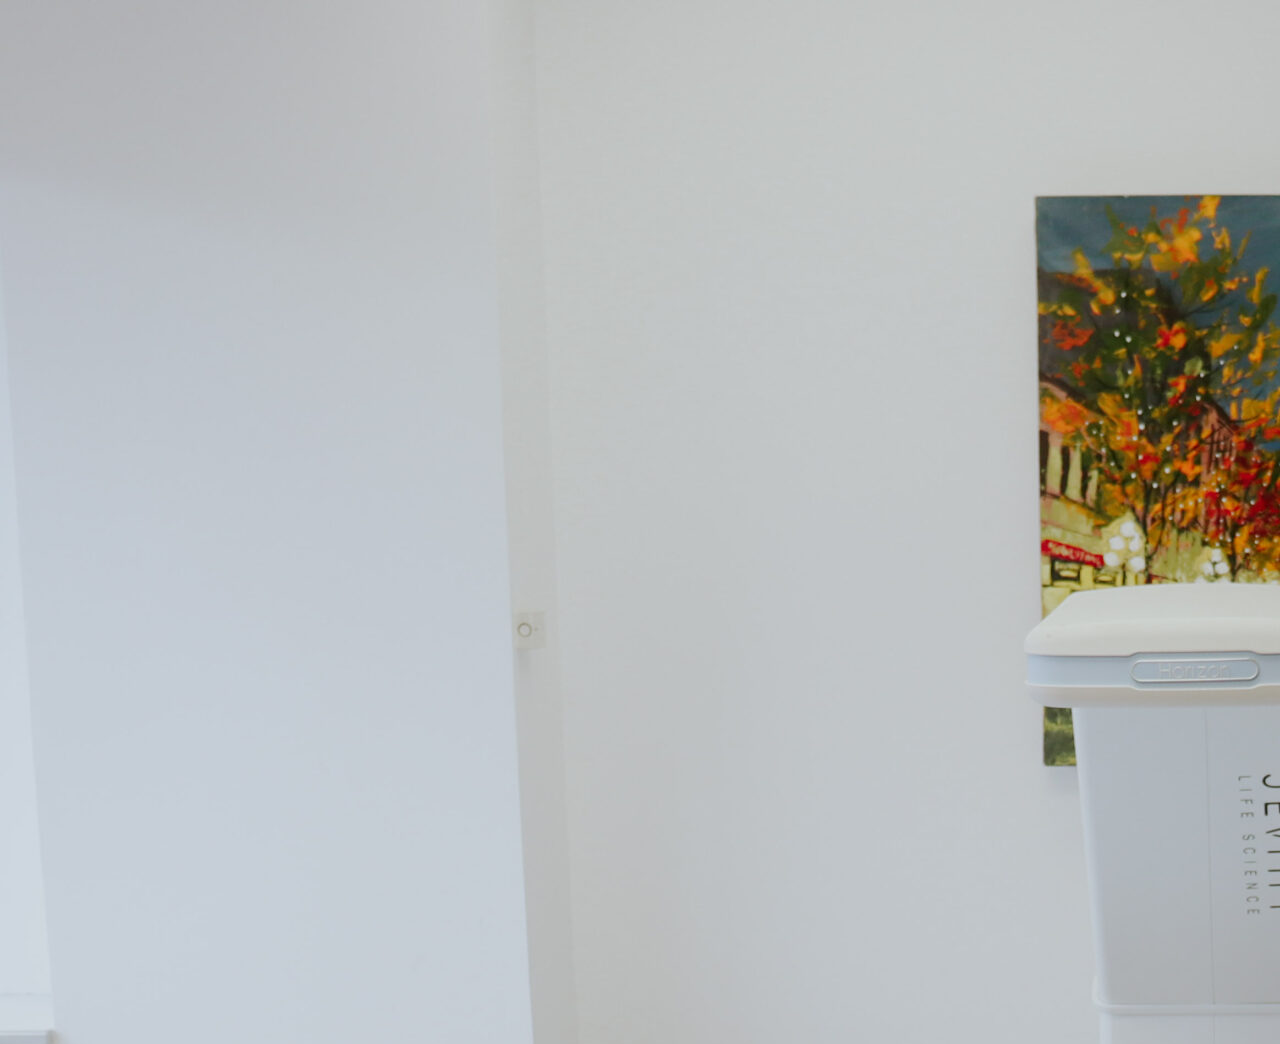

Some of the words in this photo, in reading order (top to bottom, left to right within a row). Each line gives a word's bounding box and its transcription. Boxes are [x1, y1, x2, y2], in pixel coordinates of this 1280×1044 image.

[1158, 663, 1231, 680] Horizon
[1238, 775, 1255, 819] LIFE
[1242, 833, 1260, 915] SCIENCE
